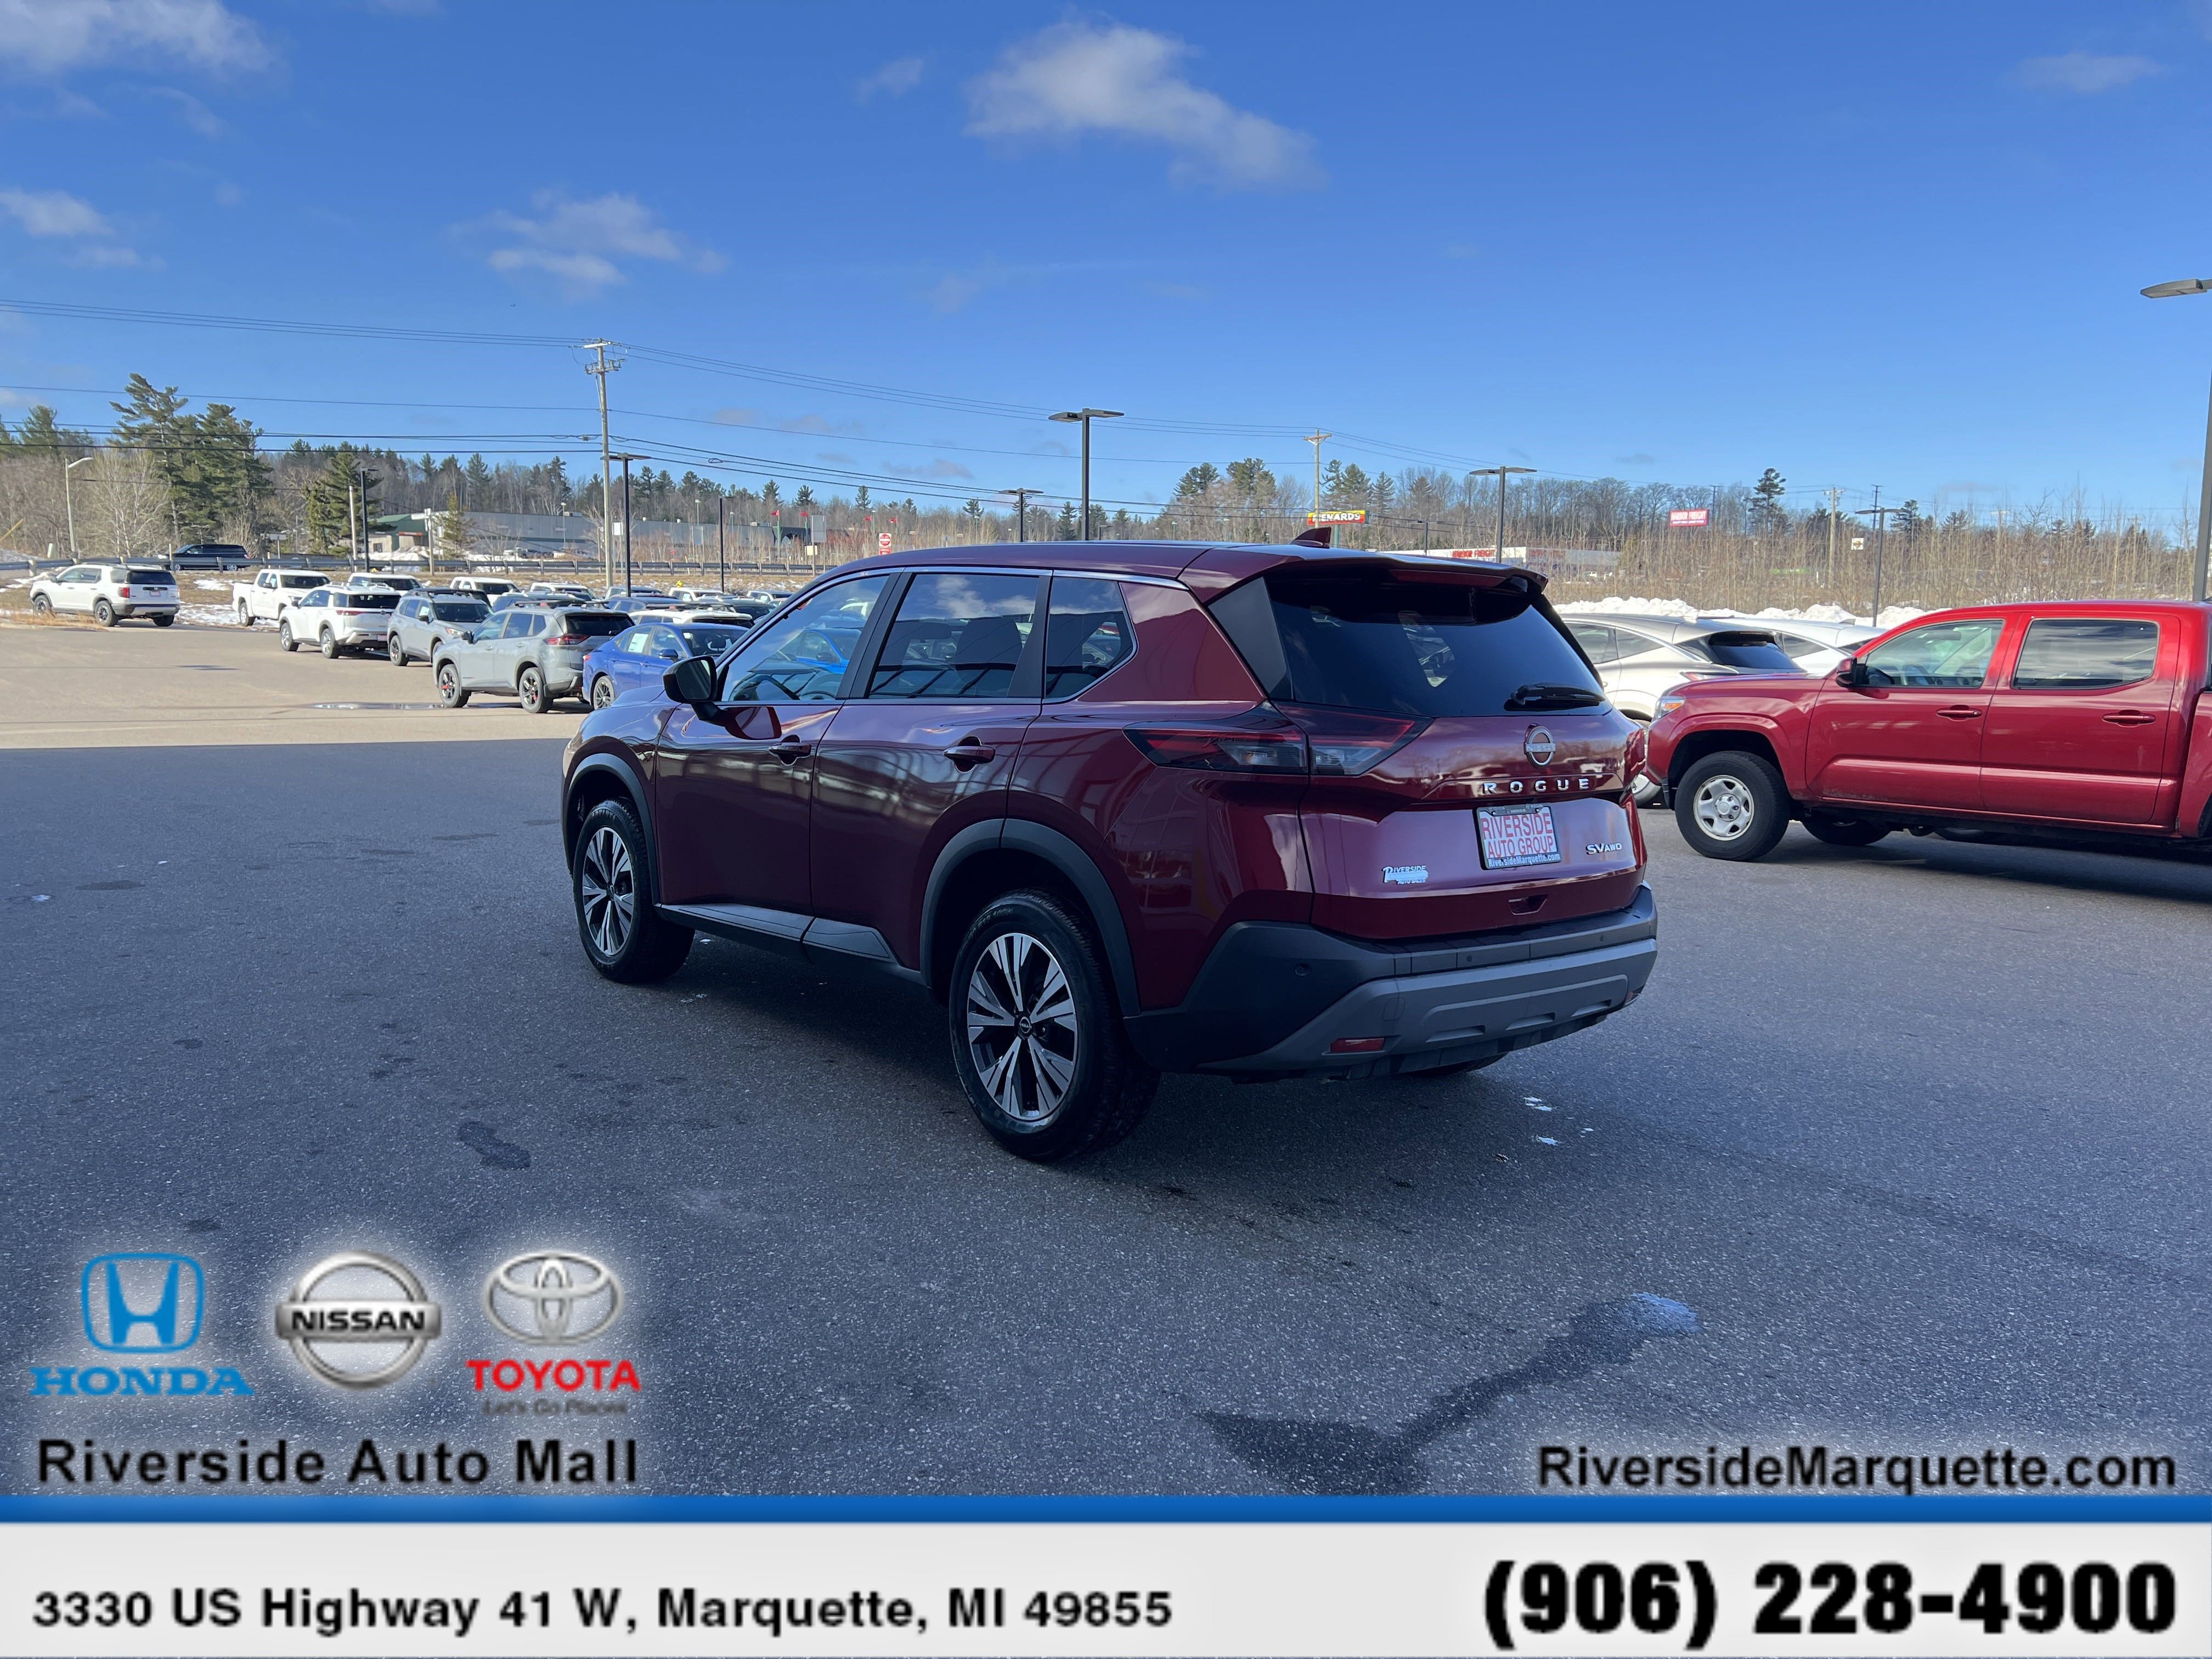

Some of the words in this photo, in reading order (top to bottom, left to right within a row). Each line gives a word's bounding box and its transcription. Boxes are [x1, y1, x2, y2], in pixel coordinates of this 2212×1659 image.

[1312, 512, 1361, 522] MENARDS
[1527, 743, 1556, 752] NISSAN
[1483, 778, 1589, 794] ROGUE
[1482, 812, 1553, 839] RIVERSIDE
[1488, 839, 1515, 858] AUTO
[1517, 835, 1553, 856] GROUP
[1382, 865, 1426, 883] RIVERSIDE
